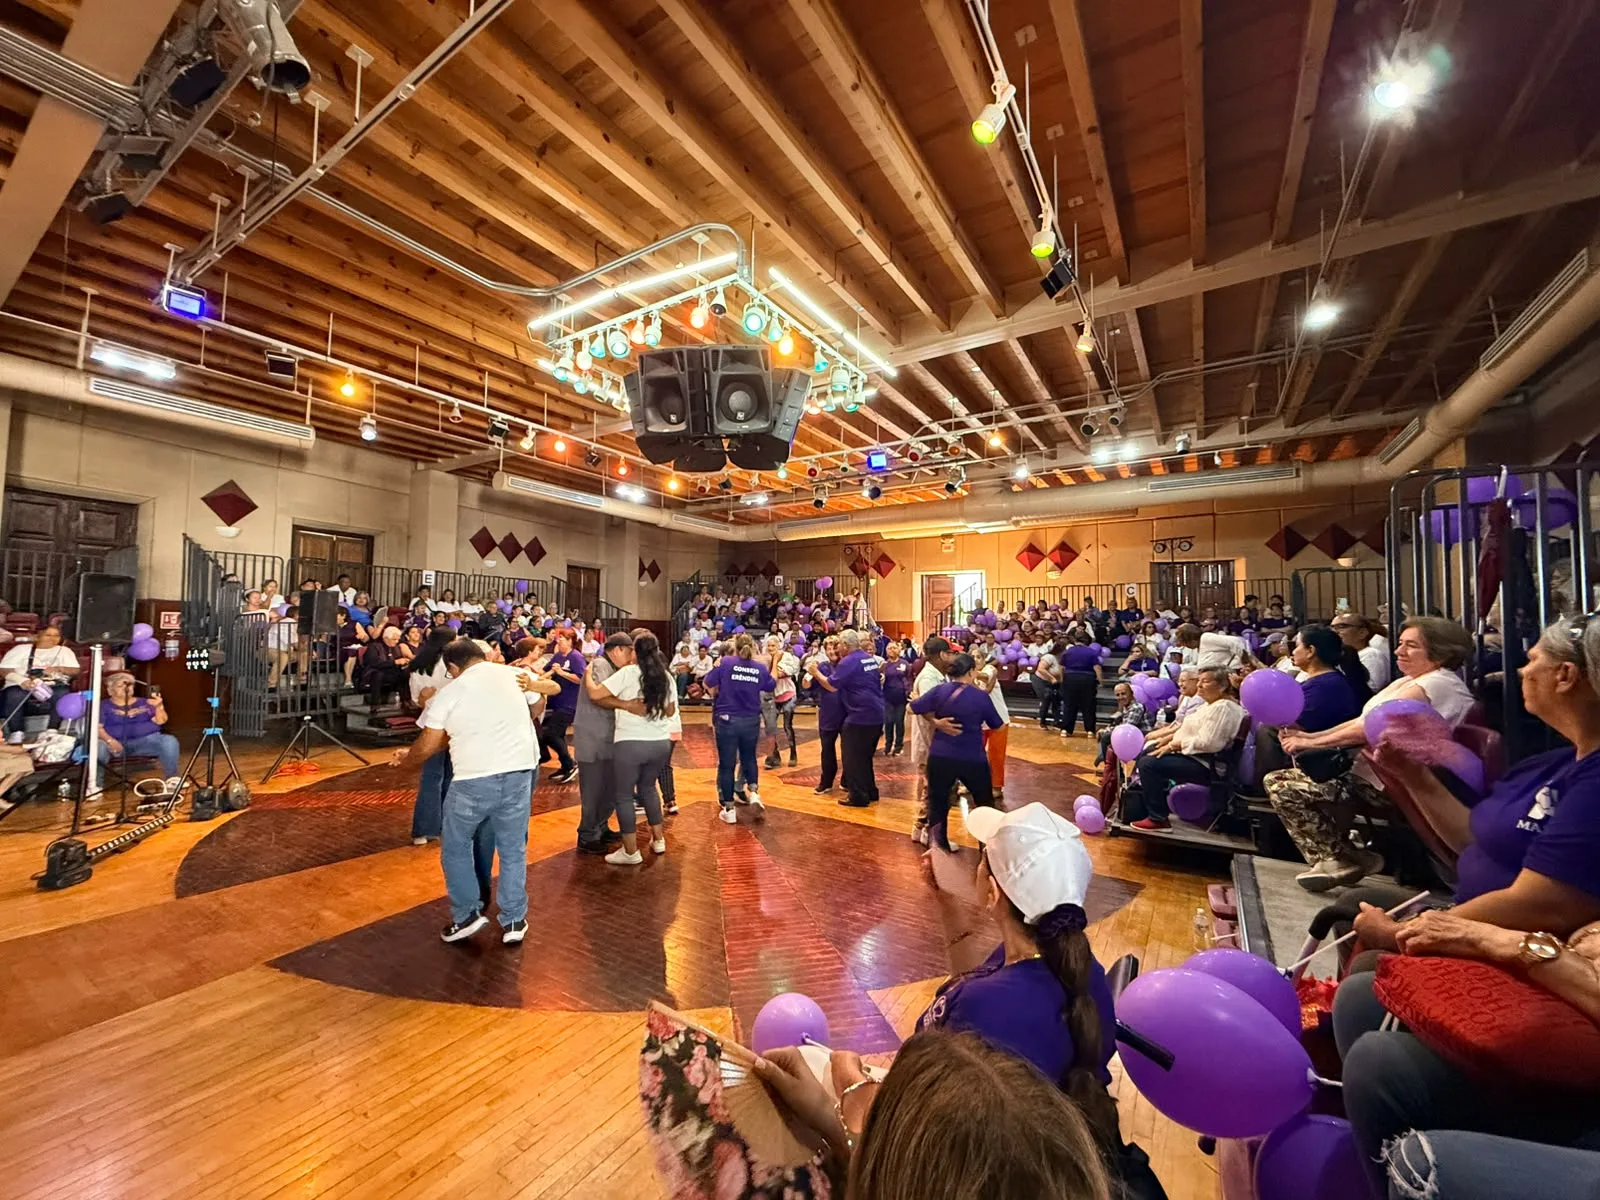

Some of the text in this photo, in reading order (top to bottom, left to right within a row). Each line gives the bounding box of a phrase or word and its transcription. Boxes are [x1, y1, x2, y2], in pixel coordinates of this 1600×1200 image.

[425, 574, 432, 583] E
[1126, 586, 1135, 595] C
[733, 665, 760, 675] CONSEJO
